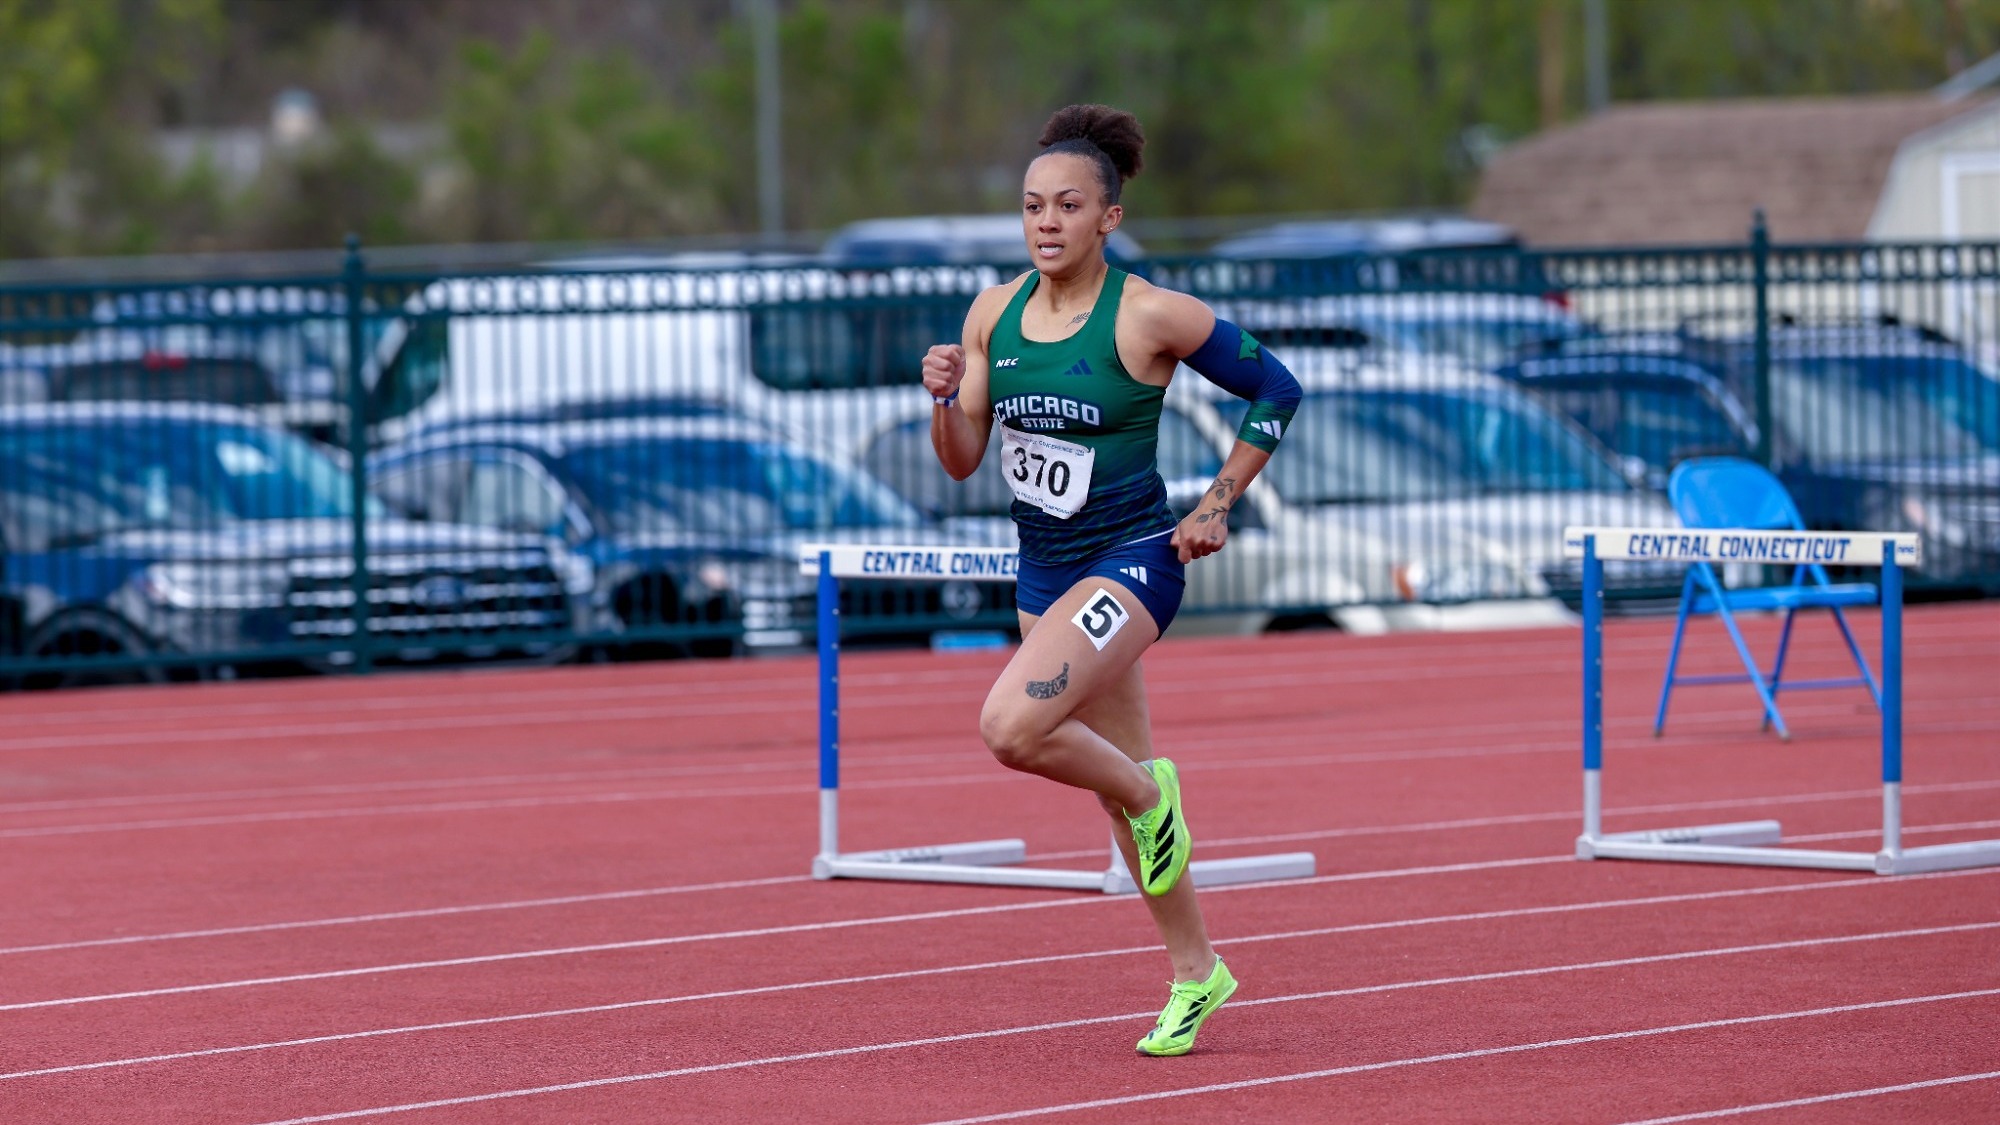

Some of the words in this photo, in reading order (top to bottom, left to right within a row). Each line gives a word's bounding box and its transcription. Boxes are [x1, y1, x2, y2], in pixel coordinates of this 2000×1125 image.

[995, 357, 1019, 368] NEC
[995, 395, 1100, 426] CHICAGO
[1020, 417, 1066, 429] STATE
[1013, 447, 1070, 497] 370
[1629, 534, 1711, 557] CENTRAL
[1719, 536, 1850, 560] CONNECTICUT
[863, 552, 943, 574] CENTRAL
[1082, 595, 1123, 639] 5
